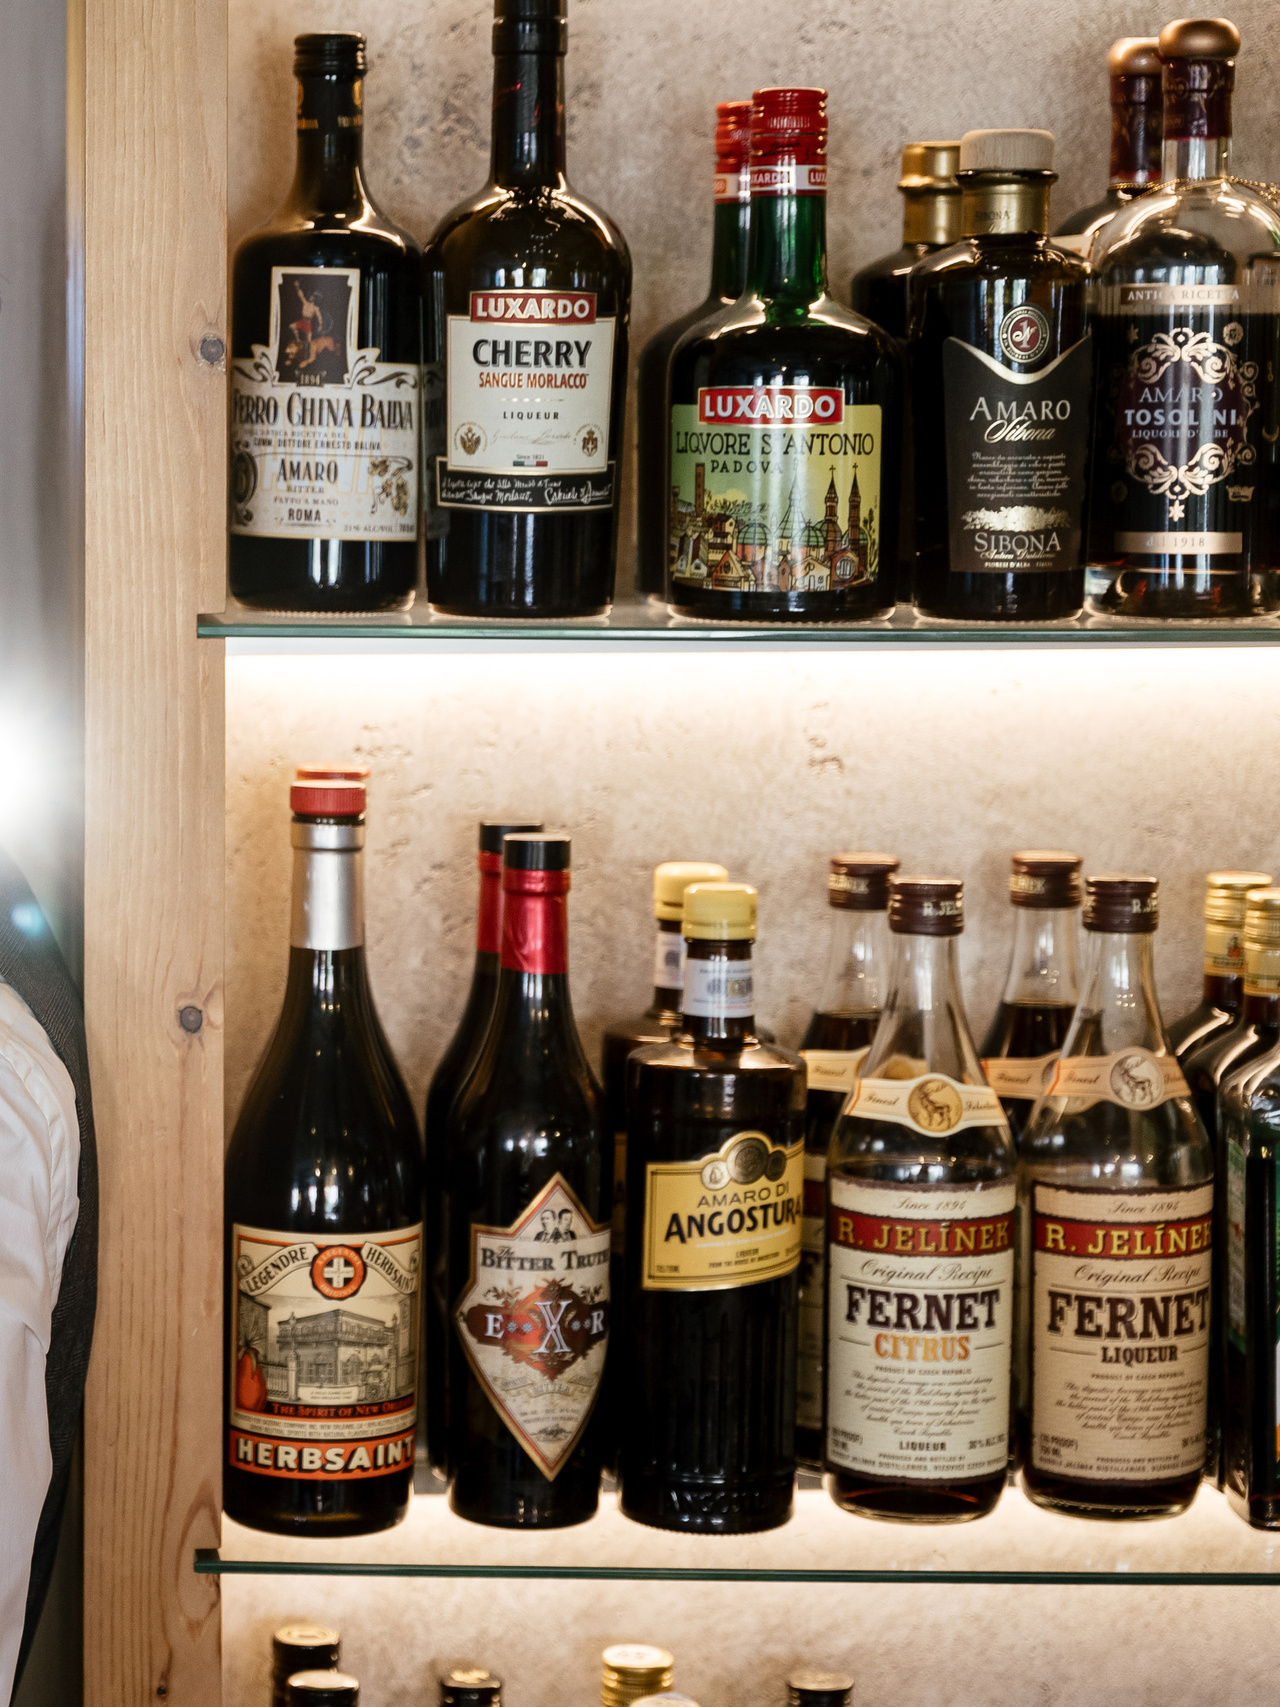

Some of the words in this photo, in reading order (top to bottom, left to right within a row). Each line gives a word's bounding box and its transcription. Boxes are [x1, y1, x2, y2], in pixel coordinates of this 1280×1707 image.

[476, 297, 590, 319] LUXARDO
[473, 339, 593, 369] CHERRY
[479, 372, 523, 389] SANGUE
[527, 372, 588, 390] MORLACCO
[287, 391, 355, 428] CHINA
[361, 392, 414, 430] BALIVA
[503, 411, 560, 421] LIQUEUR
[705, 395, 836, 419] LUXARDO
[970, 396, 1071, 421] AMARO
[1125, 409, 1237, 426] TOSOLNI
[984, 416, 1057, 444] Sibona
[278, 457, 339, 484] AMARO
[711, 460, 783, 474] PADOVA
[286, 485, 325, 494] BITTER
[288, 508, 322, 522] ROMA
[974, 531, 1061, 552] SIBONA
[1173, 537, 1205, 548] 1918
[697, 1187, 771, 1208] AMARO
[776, 1181, 790, 1198] DI
[893, 1196, 930, 1211] Since
[934, 1199, 968, 1212] 1894
[1107, 1200, 1147, 1214] Since
[1150, 1201, 1179, 1214] 1894
[664, 1195, 802, 1244] ANGOSTURA
[838, 1216, 865, 1246] R.
[873, 1221, 1010, 1252] JELÍNEK
[1045, 1222, 1076, 1252] R.
[245, 1246, 310, 1294] LEGENDRE
[364, 1246, 416, 1292] HERBSAINT
[481, 1247, 555, 1272] BITTER
[860, 1259, 938, 1284] Original
[938, 1263, 993, 1286] Recipe
[1074, 1264, 1157, 1288] Original
[1154, 1264, 1201, 1285] Recipe
[846, 1284, 1001, 1332] FERNET
[1047, 1286, 1210, 1339] FERNET
[484, 1313, 505, 1339] E
[532, 1299, 574, 1354] X
[590, 1309, 604, 1335] R
[874, 1332, 971, 1362] CITRUS
[1101, 1344, 1178, 1367] LIQUEUR
[273, 1403, 295, 1416] THE
[298, 1405, 334, 1417] SPIRIT
[338, 1406, 352, 1417] OF
[355, 1404, 380, 1416] NEW
[237, 1436, 416, 1473] HERBSAINT
[899, 1440, 947, 1451] LIQUEUR
